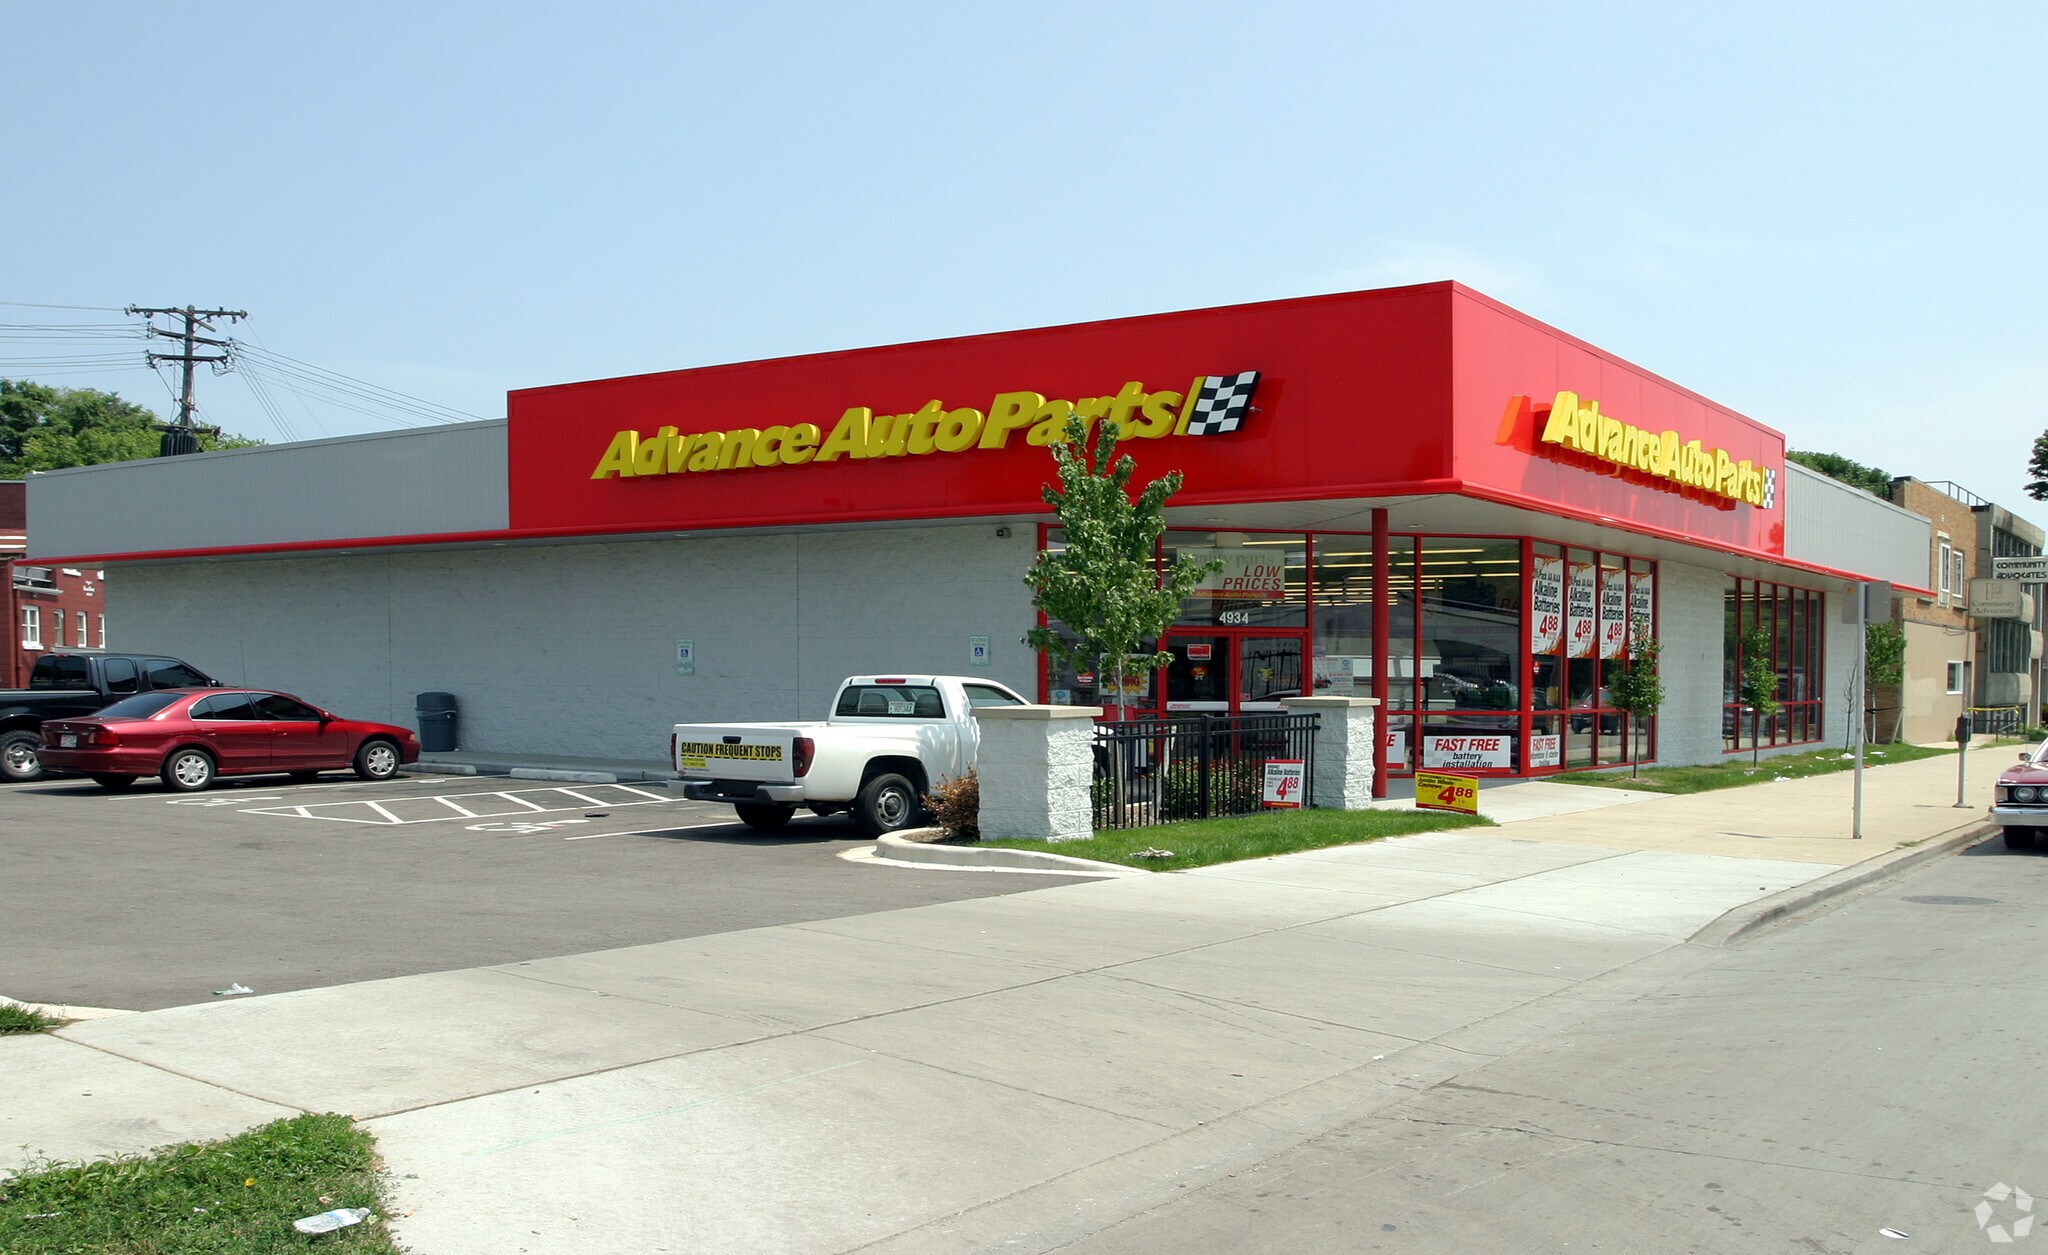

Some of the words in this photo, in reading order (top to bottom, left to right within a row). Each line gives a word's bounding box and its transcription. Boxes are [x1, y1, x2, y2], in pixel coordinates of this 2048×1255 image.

[590, 423, 821, 480] Advance
[813, 399, 984, 462] Auto
[978, 381, 1184, 449] Parts
[1541, 390, 1662, 475] Advance
[1654, 430, 1715, 491] Auto
[1708, 448, 1762, 506] Parts
[1244, 565, 1281, 577] LOW
[1996, 561, 2047, 569] COMMUNITY
[1997, 571, 2047, 579] ADVOCATES
[1222, 577, 1281, 590] PRICES
[1534, 580, 1558, 598] Alkaline
[1534, 596, 1560, 614] Batteries
[1219, 612, 1249, 624] 4934
[681, 742, 714, 755] CAUTION
[715, 743, 754, 757] FREQUENT
[755, 745, 782, 757] STOPS
[1434, 739, 1467, 751] FAST
[1469, 738, 1501, 751] FREE
[1453, 752, 1483, 760] battery
[1443, 760, 1493, 768] installation
